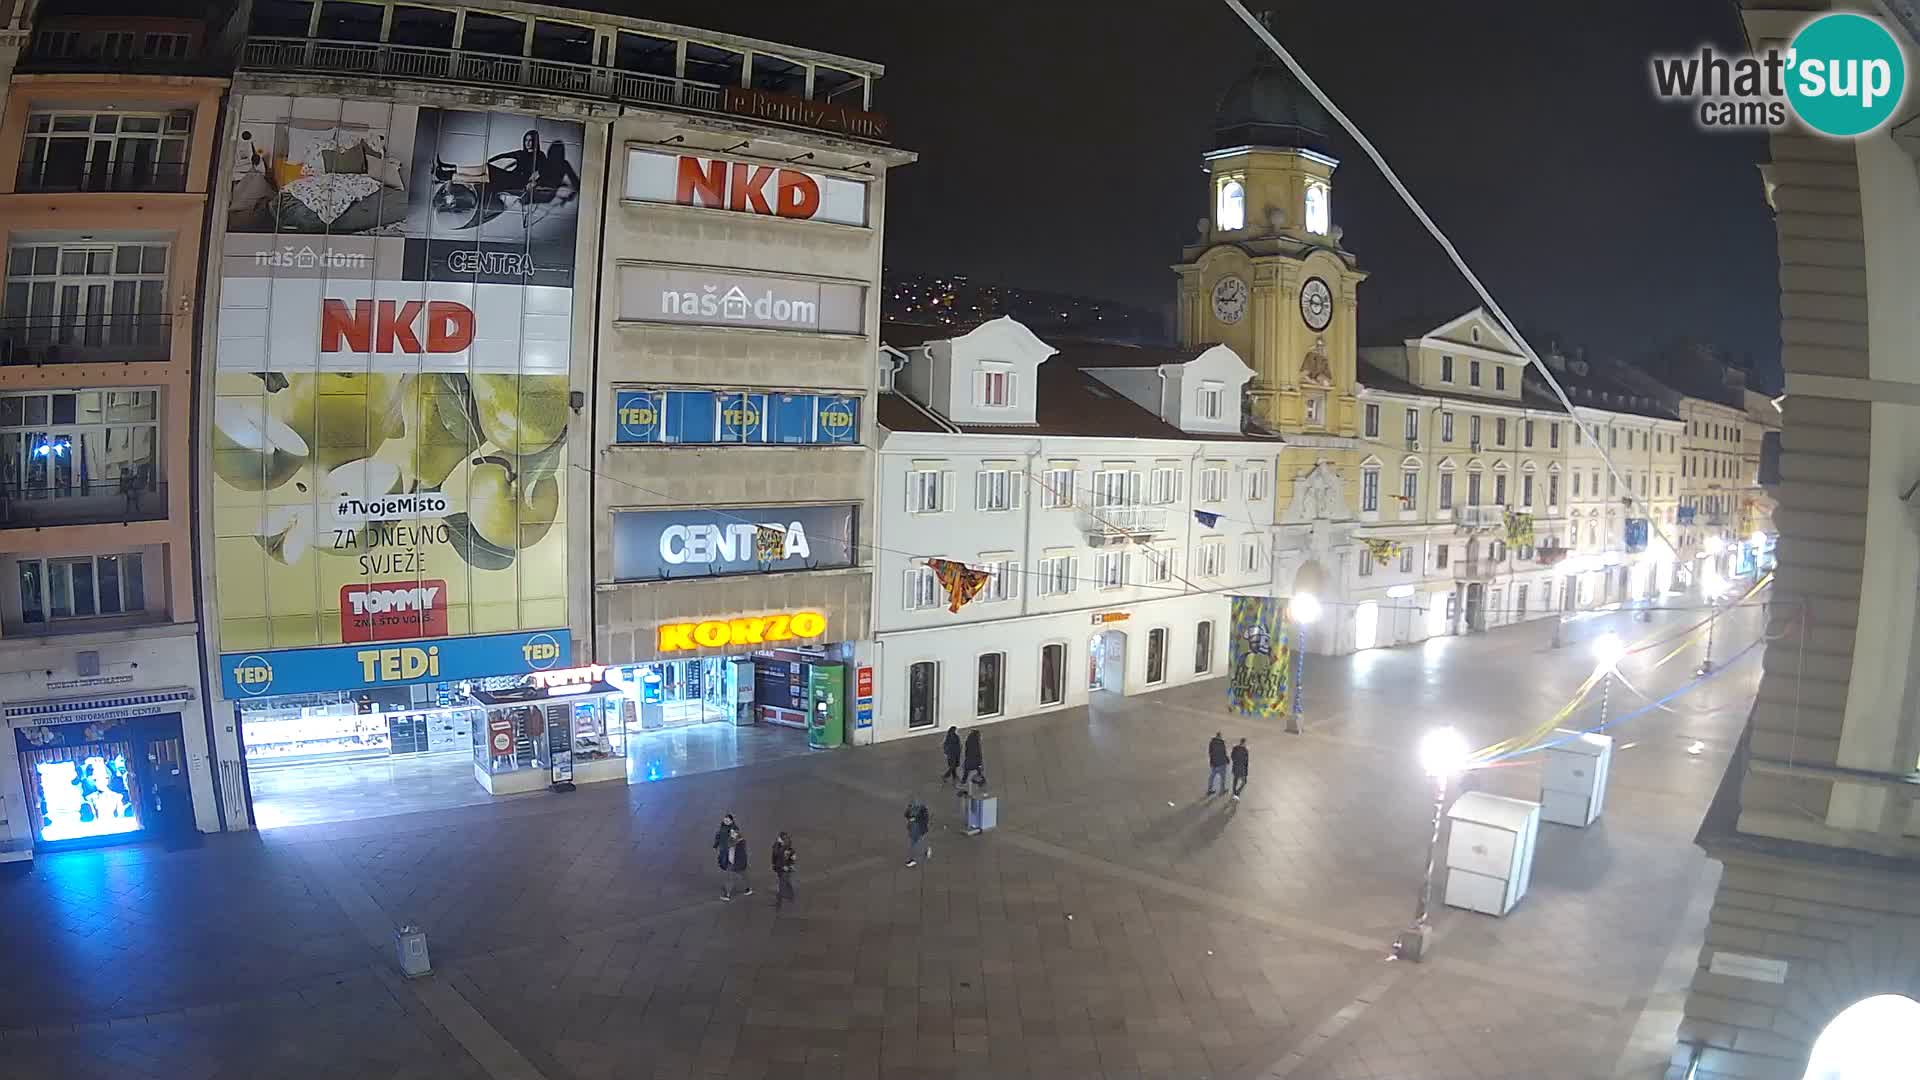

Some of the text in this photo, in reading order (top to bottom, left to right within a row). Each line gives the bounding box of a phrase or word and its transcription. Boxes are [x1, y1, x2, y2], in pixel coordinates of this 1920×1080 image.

[676, 154, 821, 220] NKD
[319, 247, 366, 269] dom
[448, 249, 536, 277] CENTRA
[661, 284, 816, 324] naš dom
[320, 297, 478, 355] NKD
[619, 408, 658, 426] TEDi
[723, 409, 760, 427] TEDi
[820, 411, 853, 428] TEDi
[338, 497, 446, 517] #TvojeMisto
[333, 524, 451, 549] ZA DNEVNO
[659, 520, 811, 565] CENTA
[359, 548, 427, 576] SVJEŽE
[348, 587, 440, 615] TOMMY
[658, 612, 827, 653] KORZO
[357, 646, 440, 683] TEDi
[522, 642, 560, 662] TEDi
[233, 664, 274, 686] TEDi
[33, 706, 162, 726] TURISTIČKI INFORMATIVNI CENTAR
